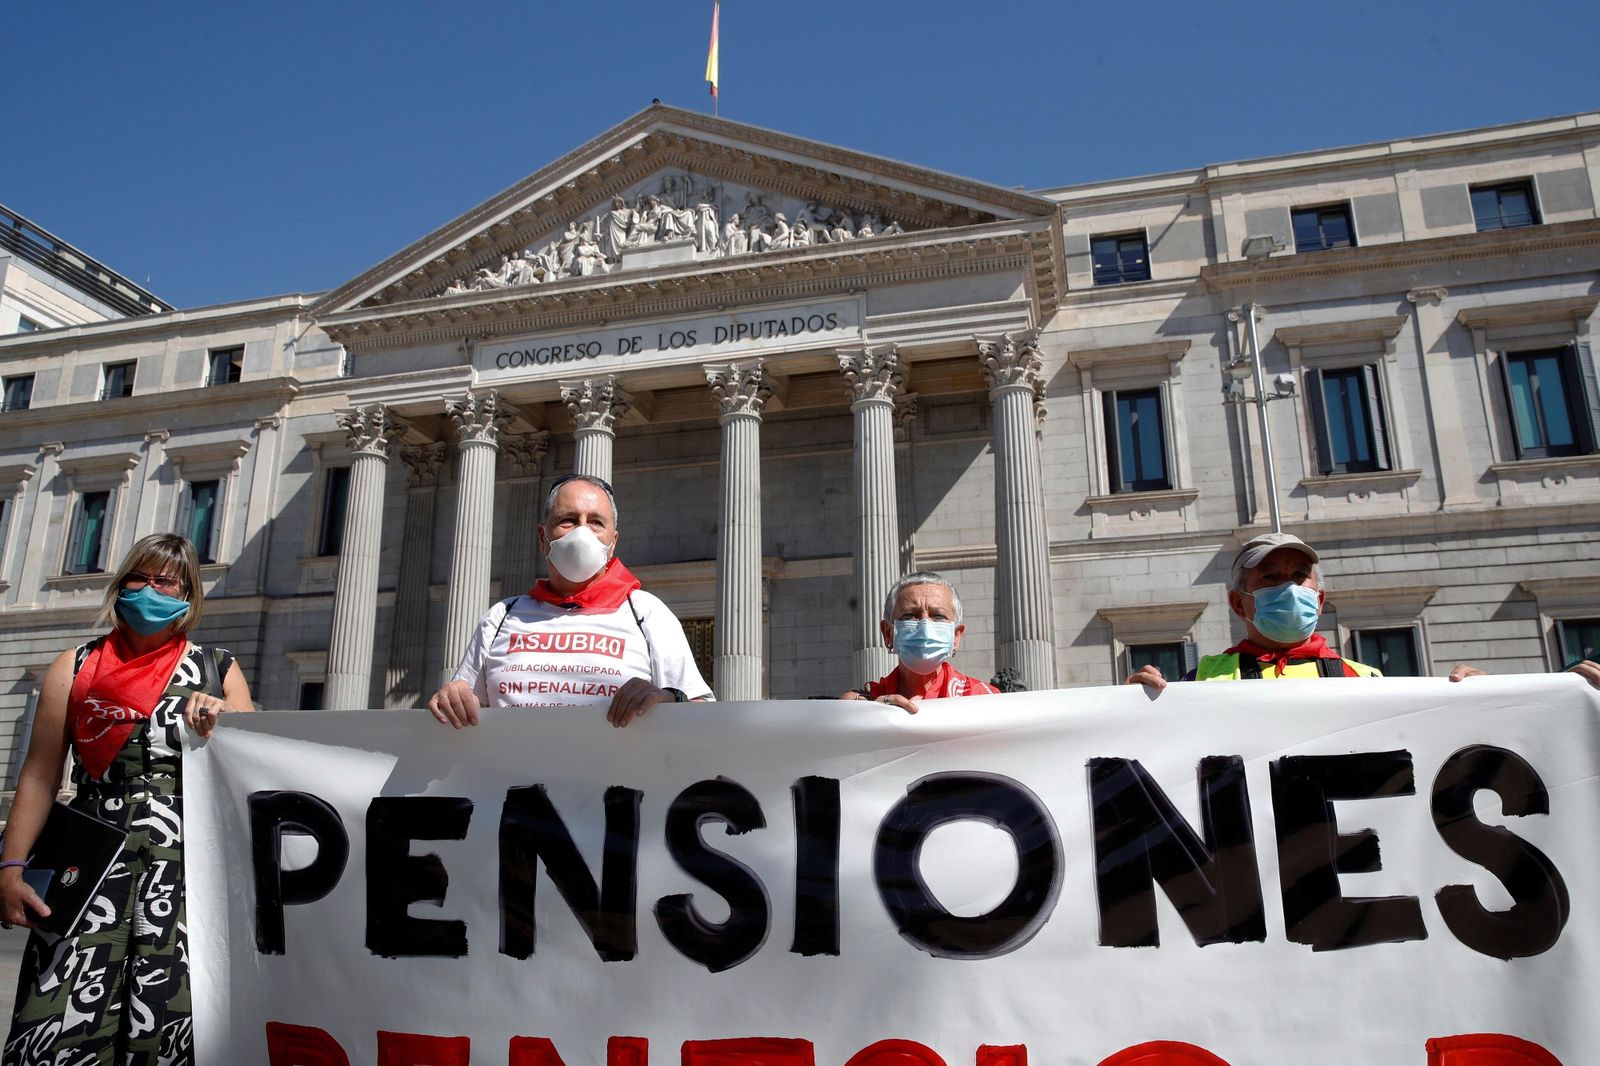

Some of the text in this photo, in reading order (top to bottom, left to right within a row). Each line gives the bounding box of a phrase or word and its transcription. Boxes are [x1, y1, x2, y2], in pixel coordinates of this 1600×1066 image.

[496, 313, 838, 370] CONGRESO DE LOS DIPUTADOS
[511, 633, 622, 656] ASJUBI40
[560, 664, 622, 677] ANTICIPADA
[499, 681, 620, 698] SIN PENALIZAR
[247, 743, 1570, 973] PENSIONES
